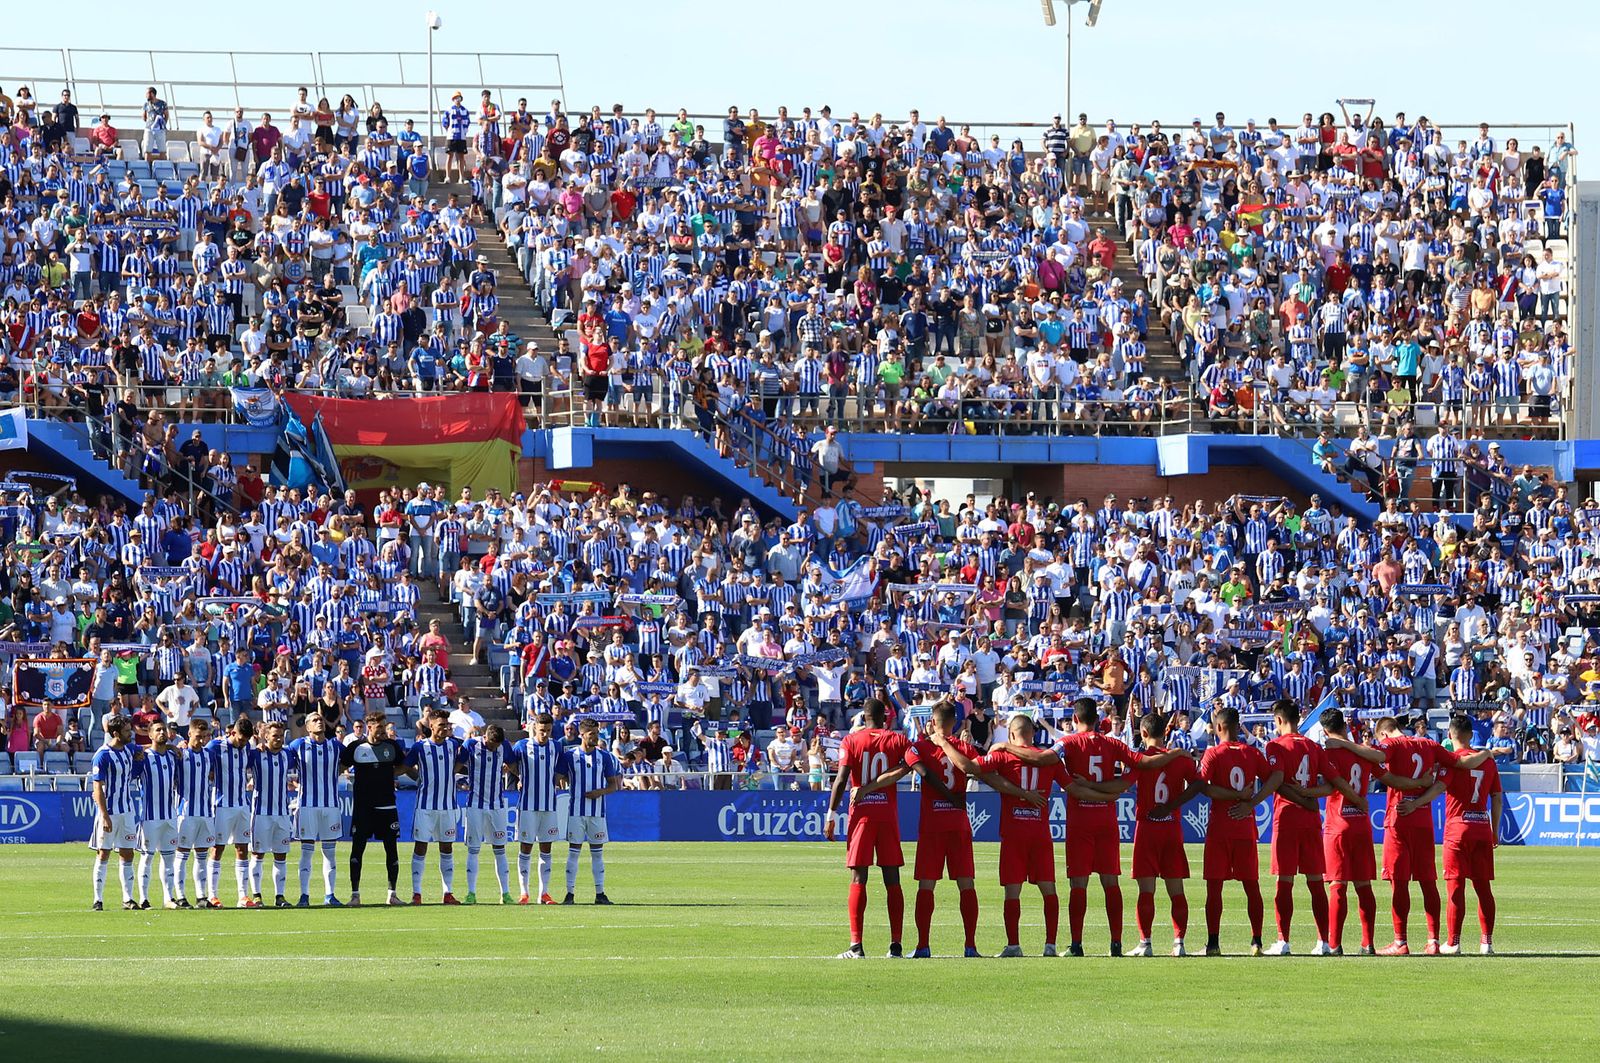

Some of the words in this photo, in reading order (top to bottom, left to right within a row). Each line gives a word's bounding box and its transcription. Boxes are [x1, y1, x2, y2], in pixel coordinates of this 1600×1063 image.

[1400, 585, 1442, 593] Recreativo
[861, 751, 889, 785] 10
[940, 756, 955, 790] 3
[1021, 766, 1039, 791] 11
[1088, 755, 1104, 783] 5
[1295, 754, 1310, 789] 4
[1349, 762, 1362, 794] 8
[1411, 752, 1423, 779] 2
[1154, 771, 1169, 804] 6
[1470, 769, 1484, 804] 7
[718, 802, 848, 836] Cruzcam
